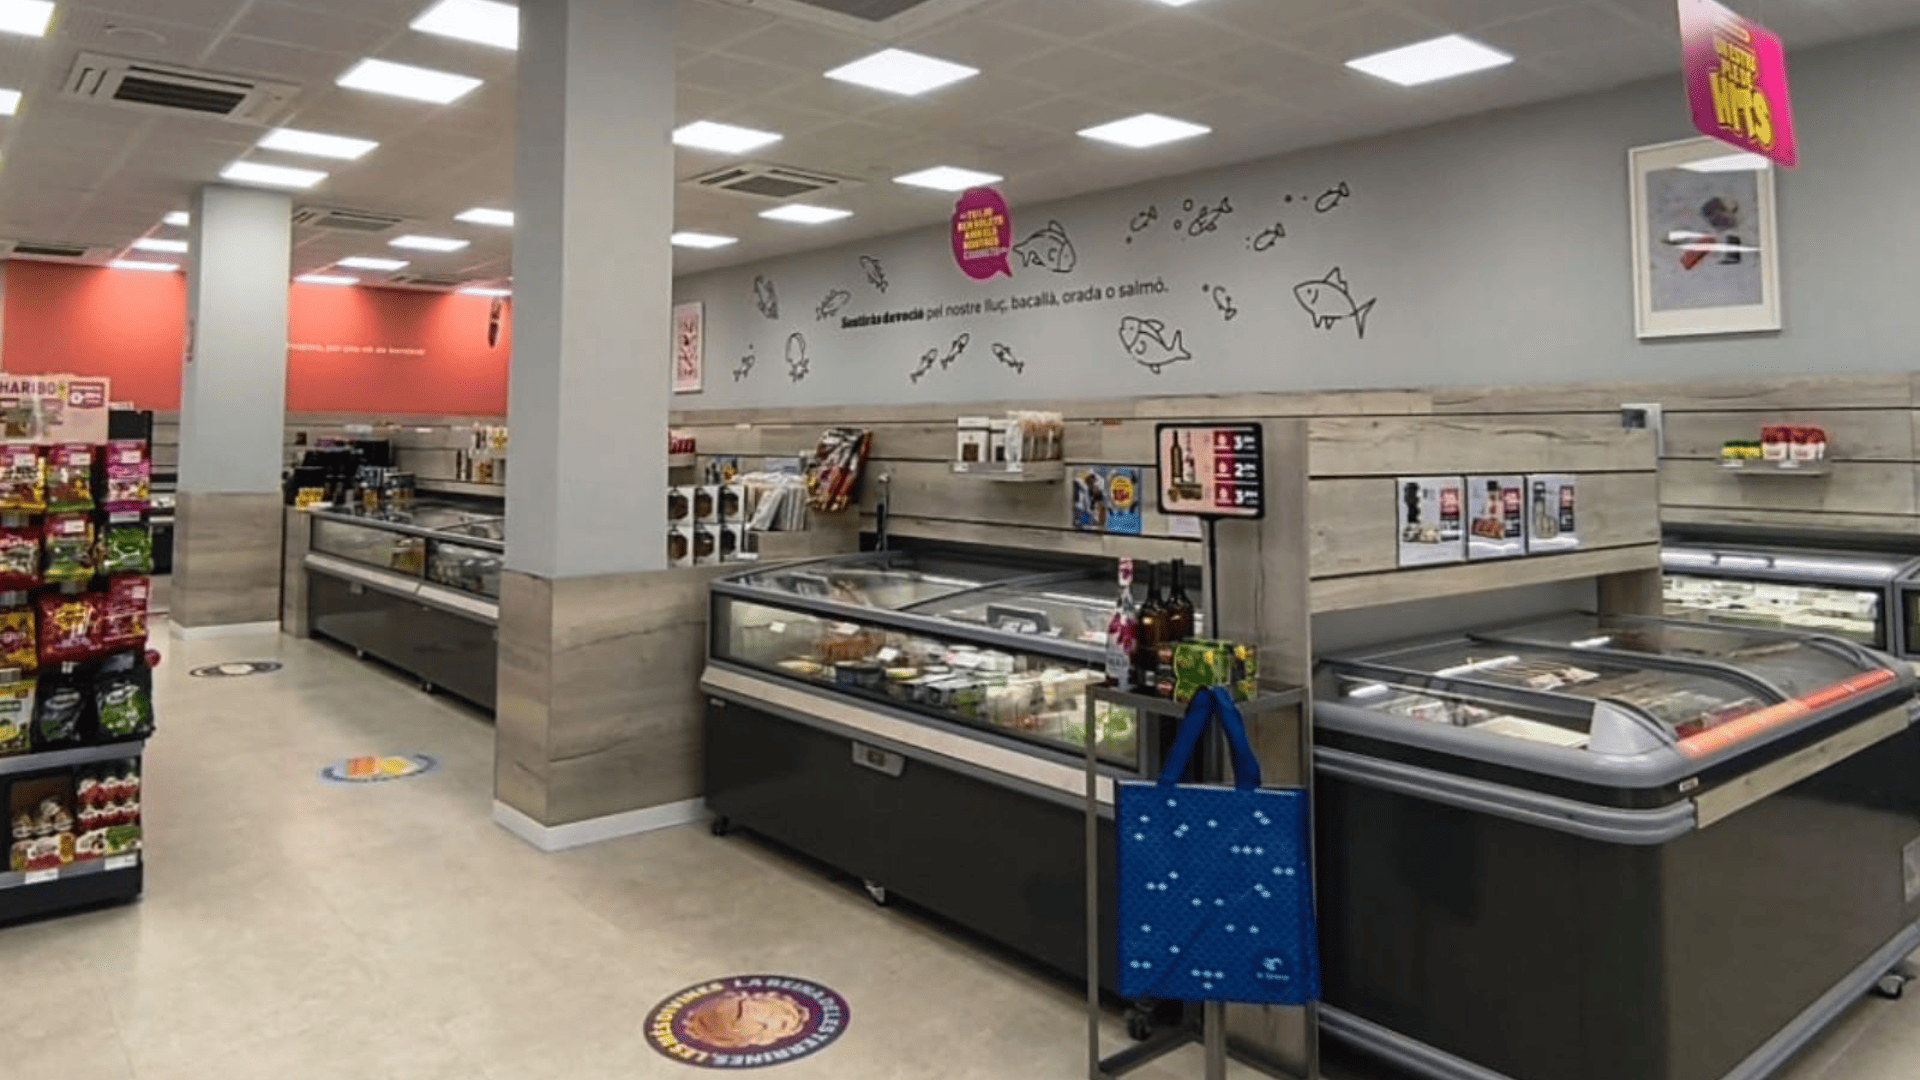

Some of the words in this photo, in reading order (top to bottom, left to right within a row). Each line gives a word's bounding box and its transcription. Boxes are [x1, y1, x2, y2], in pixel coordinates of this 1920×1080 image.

[1709, 72, 1774, 145] HITS
[926, 303, 944, 321] pel
[945, 302, 981, 317] nostre
[1011, 291, 1060, 311] bacallà,
[1062, 284, 1102, 304] orada
[1105, 286, 1116, 299] o
[1119, 276, 1169, 299] salmó.
[0, 381, 57, 396] HARIBO
[734, 978, 763, 989] LA
